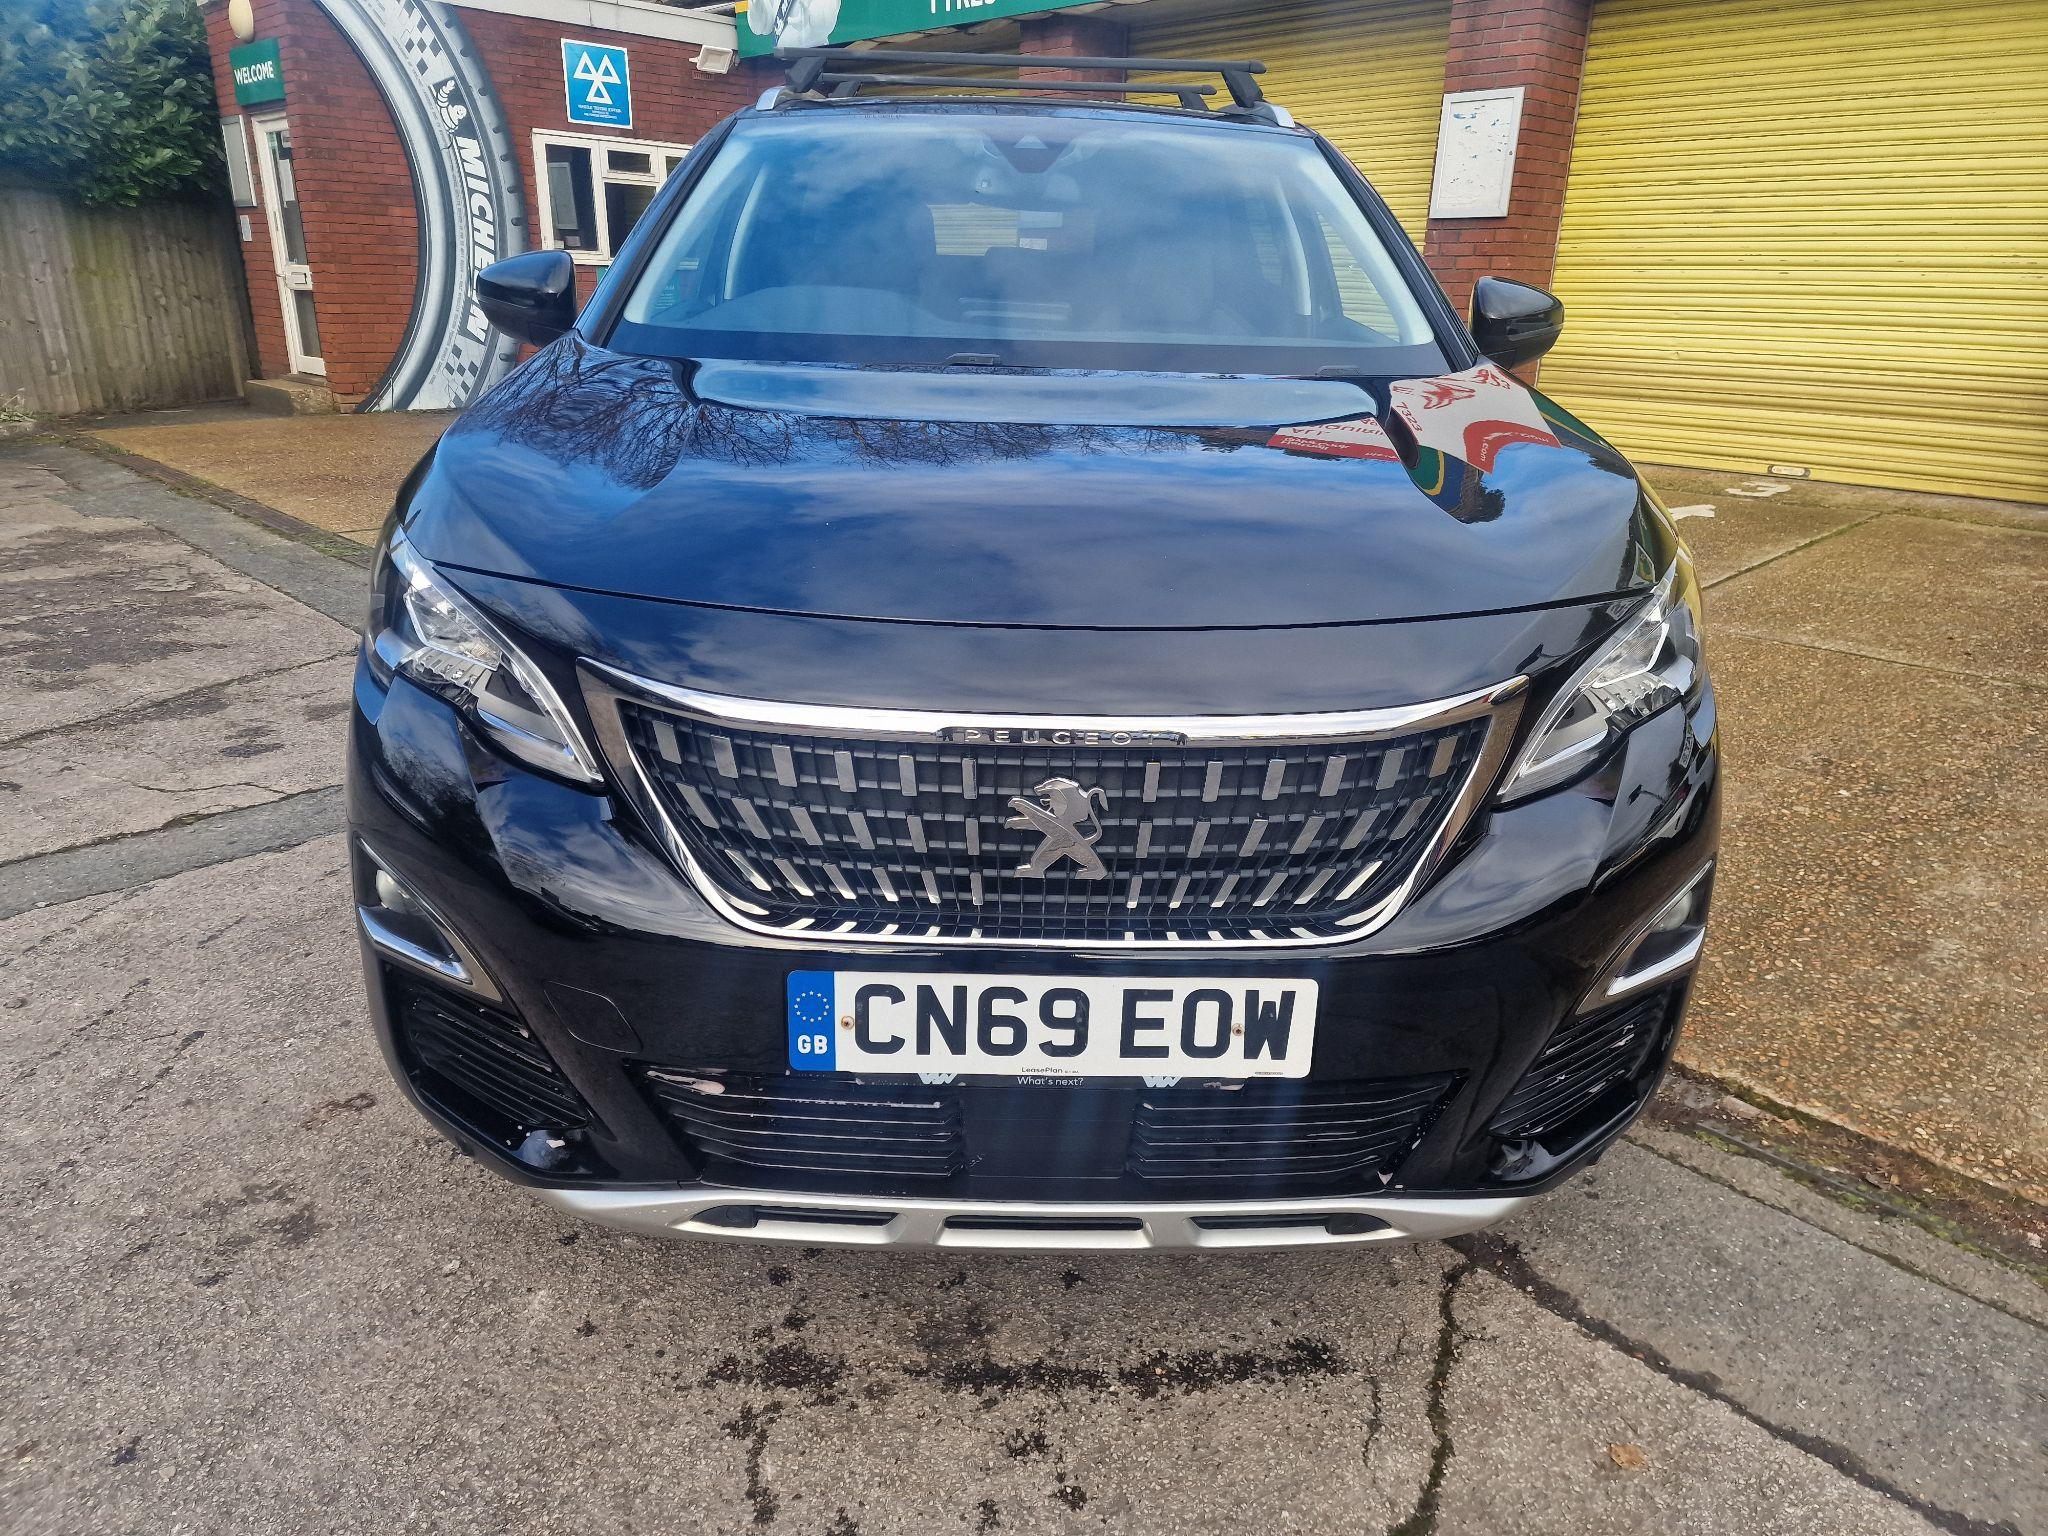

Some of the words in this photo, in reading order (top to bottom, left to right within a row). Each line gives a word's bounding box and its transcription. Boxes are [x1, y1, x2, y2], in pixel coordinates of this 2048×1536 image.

[233, 60, 275, 86] WELCOME
[456, 136, 496, 343] MICHEN
[963, 728, 1159, 745] PEUGEOT
[854, 983, 1091, 1058] CN69
[1119, 988, 1297, 1061] EOW
[797, 1034, 828, 1055] GB
[1021, 1066, 1063, 1074] LeasePlan
[1017, 1076, 1054, 1085] What's
[1055, 1077, 1084, 1086] next?
